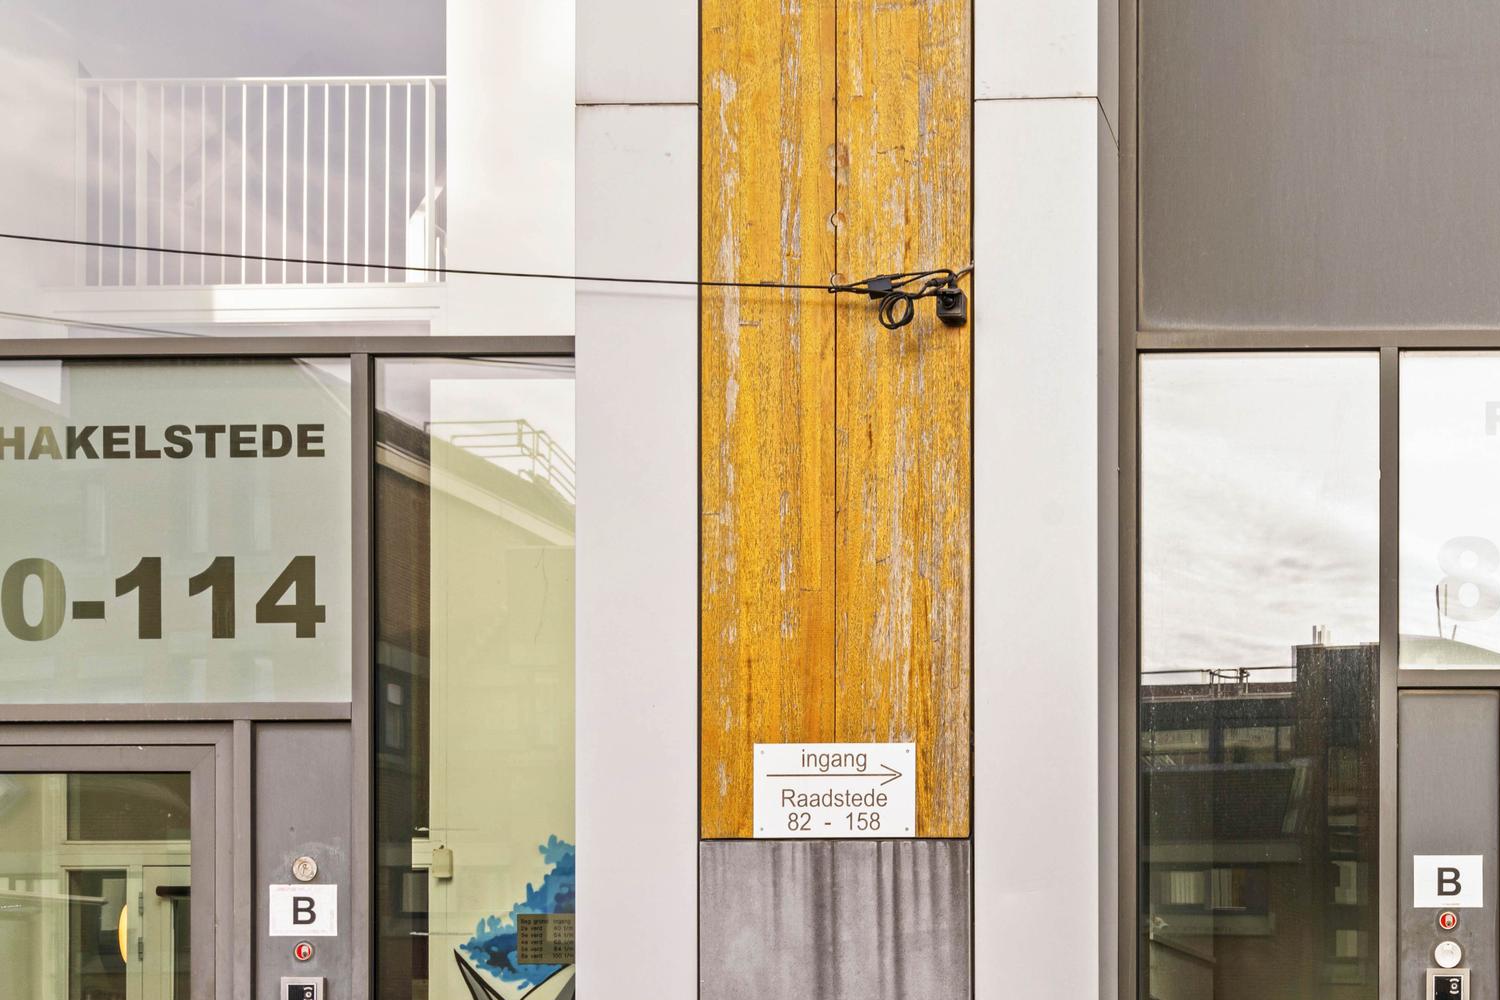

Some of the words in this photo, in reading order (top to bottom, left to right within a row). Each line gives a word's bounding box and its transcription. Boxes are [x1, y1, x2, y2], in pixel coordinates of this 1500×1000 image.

[0, 423, 325, 460] HAKELSTEDE
[1, 555, 326, 642] 0-114
[801, 749, 867, 772] ingang
[781, 788, 888, 808] Raadstede
[787, 812, 812, 831] 82
[846, 811, 881, 831] 158
[1437, 867, 1462, 896] B
[292, 896, 317, 925] B
